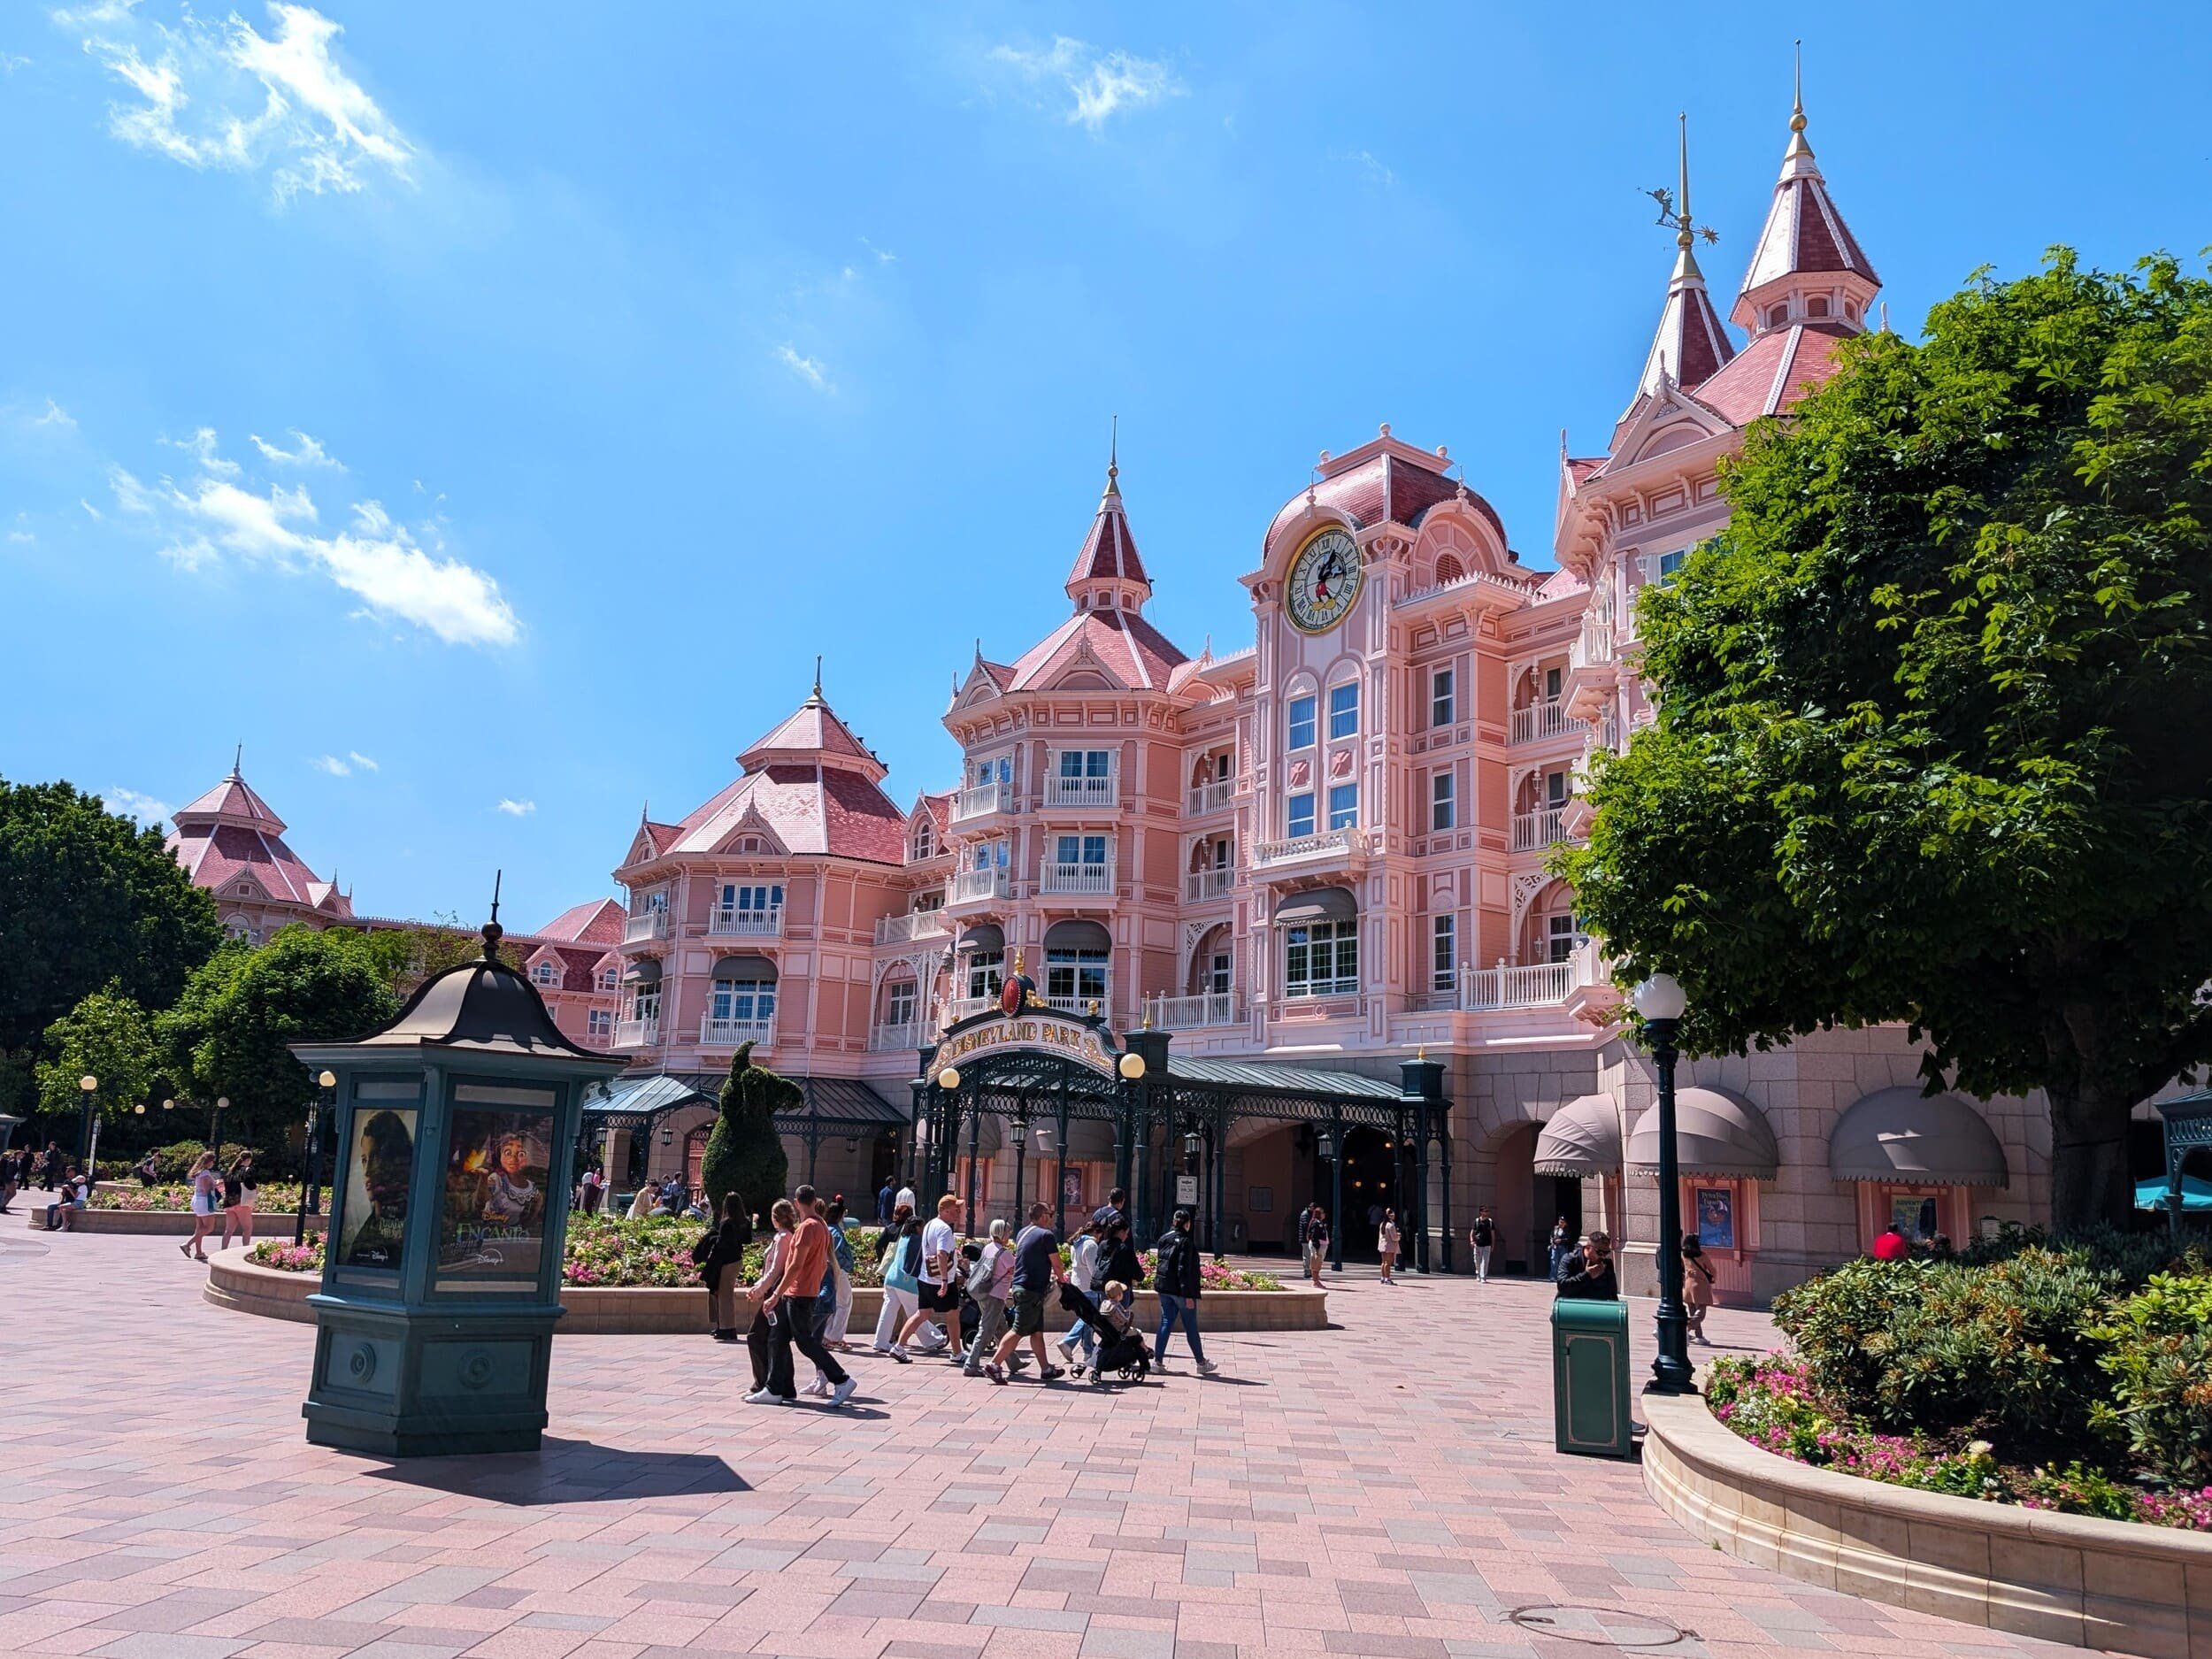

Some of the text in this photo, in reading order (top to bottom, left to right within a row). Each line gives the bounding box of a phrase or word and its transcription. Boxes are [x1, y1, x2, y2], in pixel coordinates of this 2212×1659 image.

[951, 1022, 1081, 1059] DISNEYLAND PARK
[481, 1210, 510, 1223] Disney
